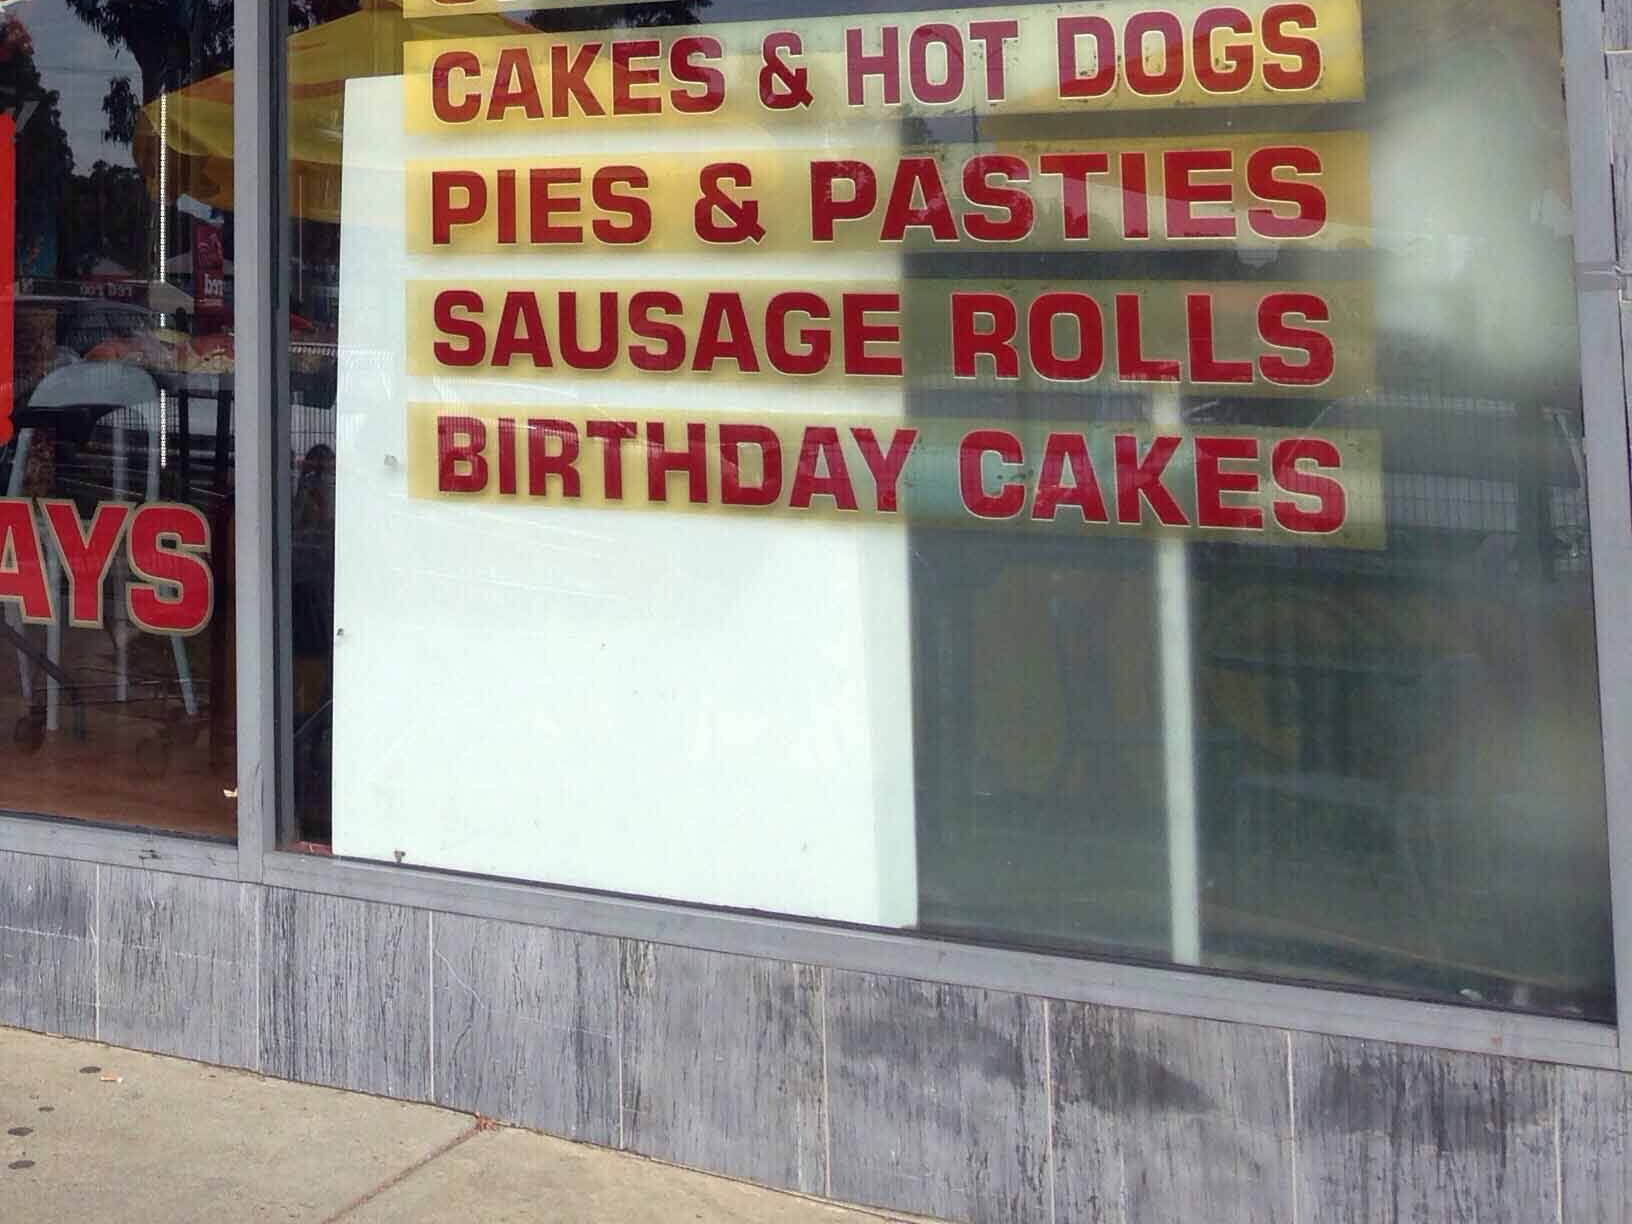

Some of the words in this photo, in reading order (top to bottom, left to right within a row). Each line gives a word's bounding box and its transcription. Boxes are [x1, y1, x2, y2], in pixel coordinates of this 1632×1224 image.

[430, 34, 727, 126] CAKES
[759, 29, 814, 112] &
[844, 18, 1021, 107] HOT
[1056, 3, 1324, 100] DOGS
[430, 164, 653, 247] PIES
[693, 162, 767, 246] &
[809, 144, 1330, 245] PASTIES
[431, 289, 905, 378] SAUSAGE
[950, 290, 1335, 389] ROLLS
[435, 416, 918, 512] BIRTHDAY
[957, 429, 1348, 536] CAKES
